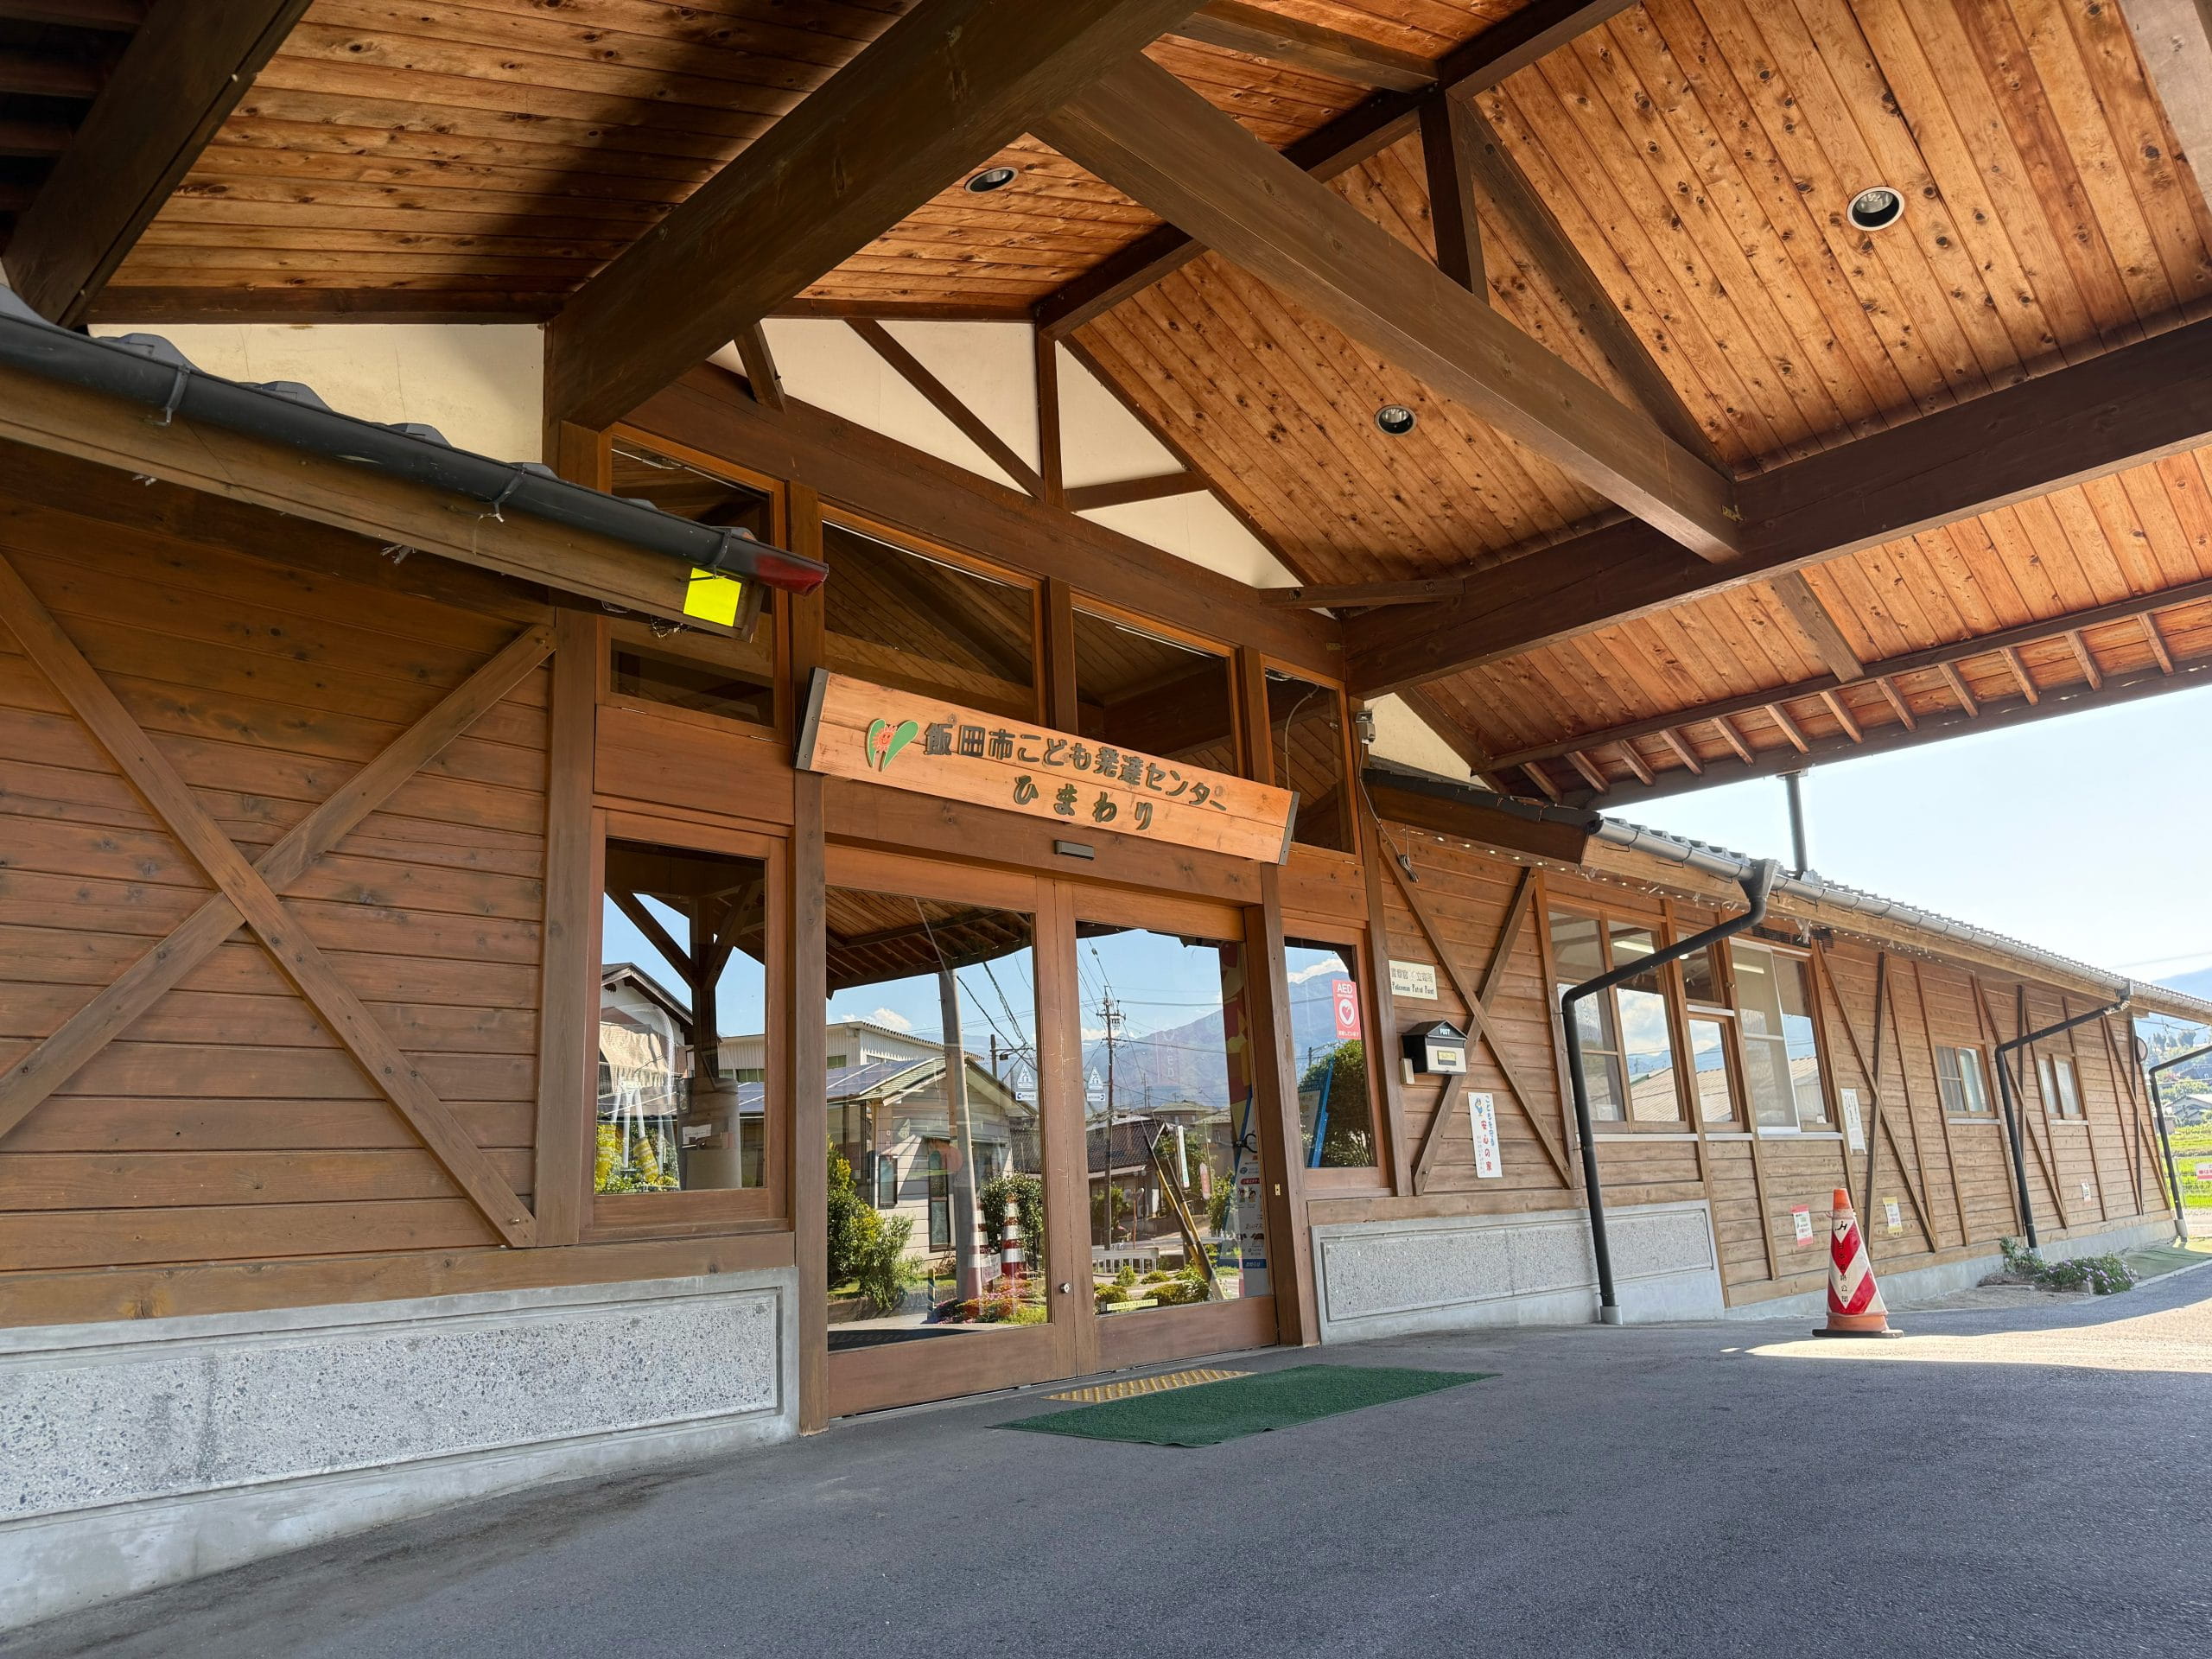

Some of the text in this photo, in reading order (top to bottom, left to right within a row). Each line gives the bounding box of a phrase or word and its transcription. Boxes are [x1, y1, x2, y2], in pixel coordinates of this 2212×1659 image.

[924, 721, 1227, 812] 飯田市こども発達センター
[1014, 774, 1154, 830] ひまわり
[1338, 983, 1353, 995] AED
